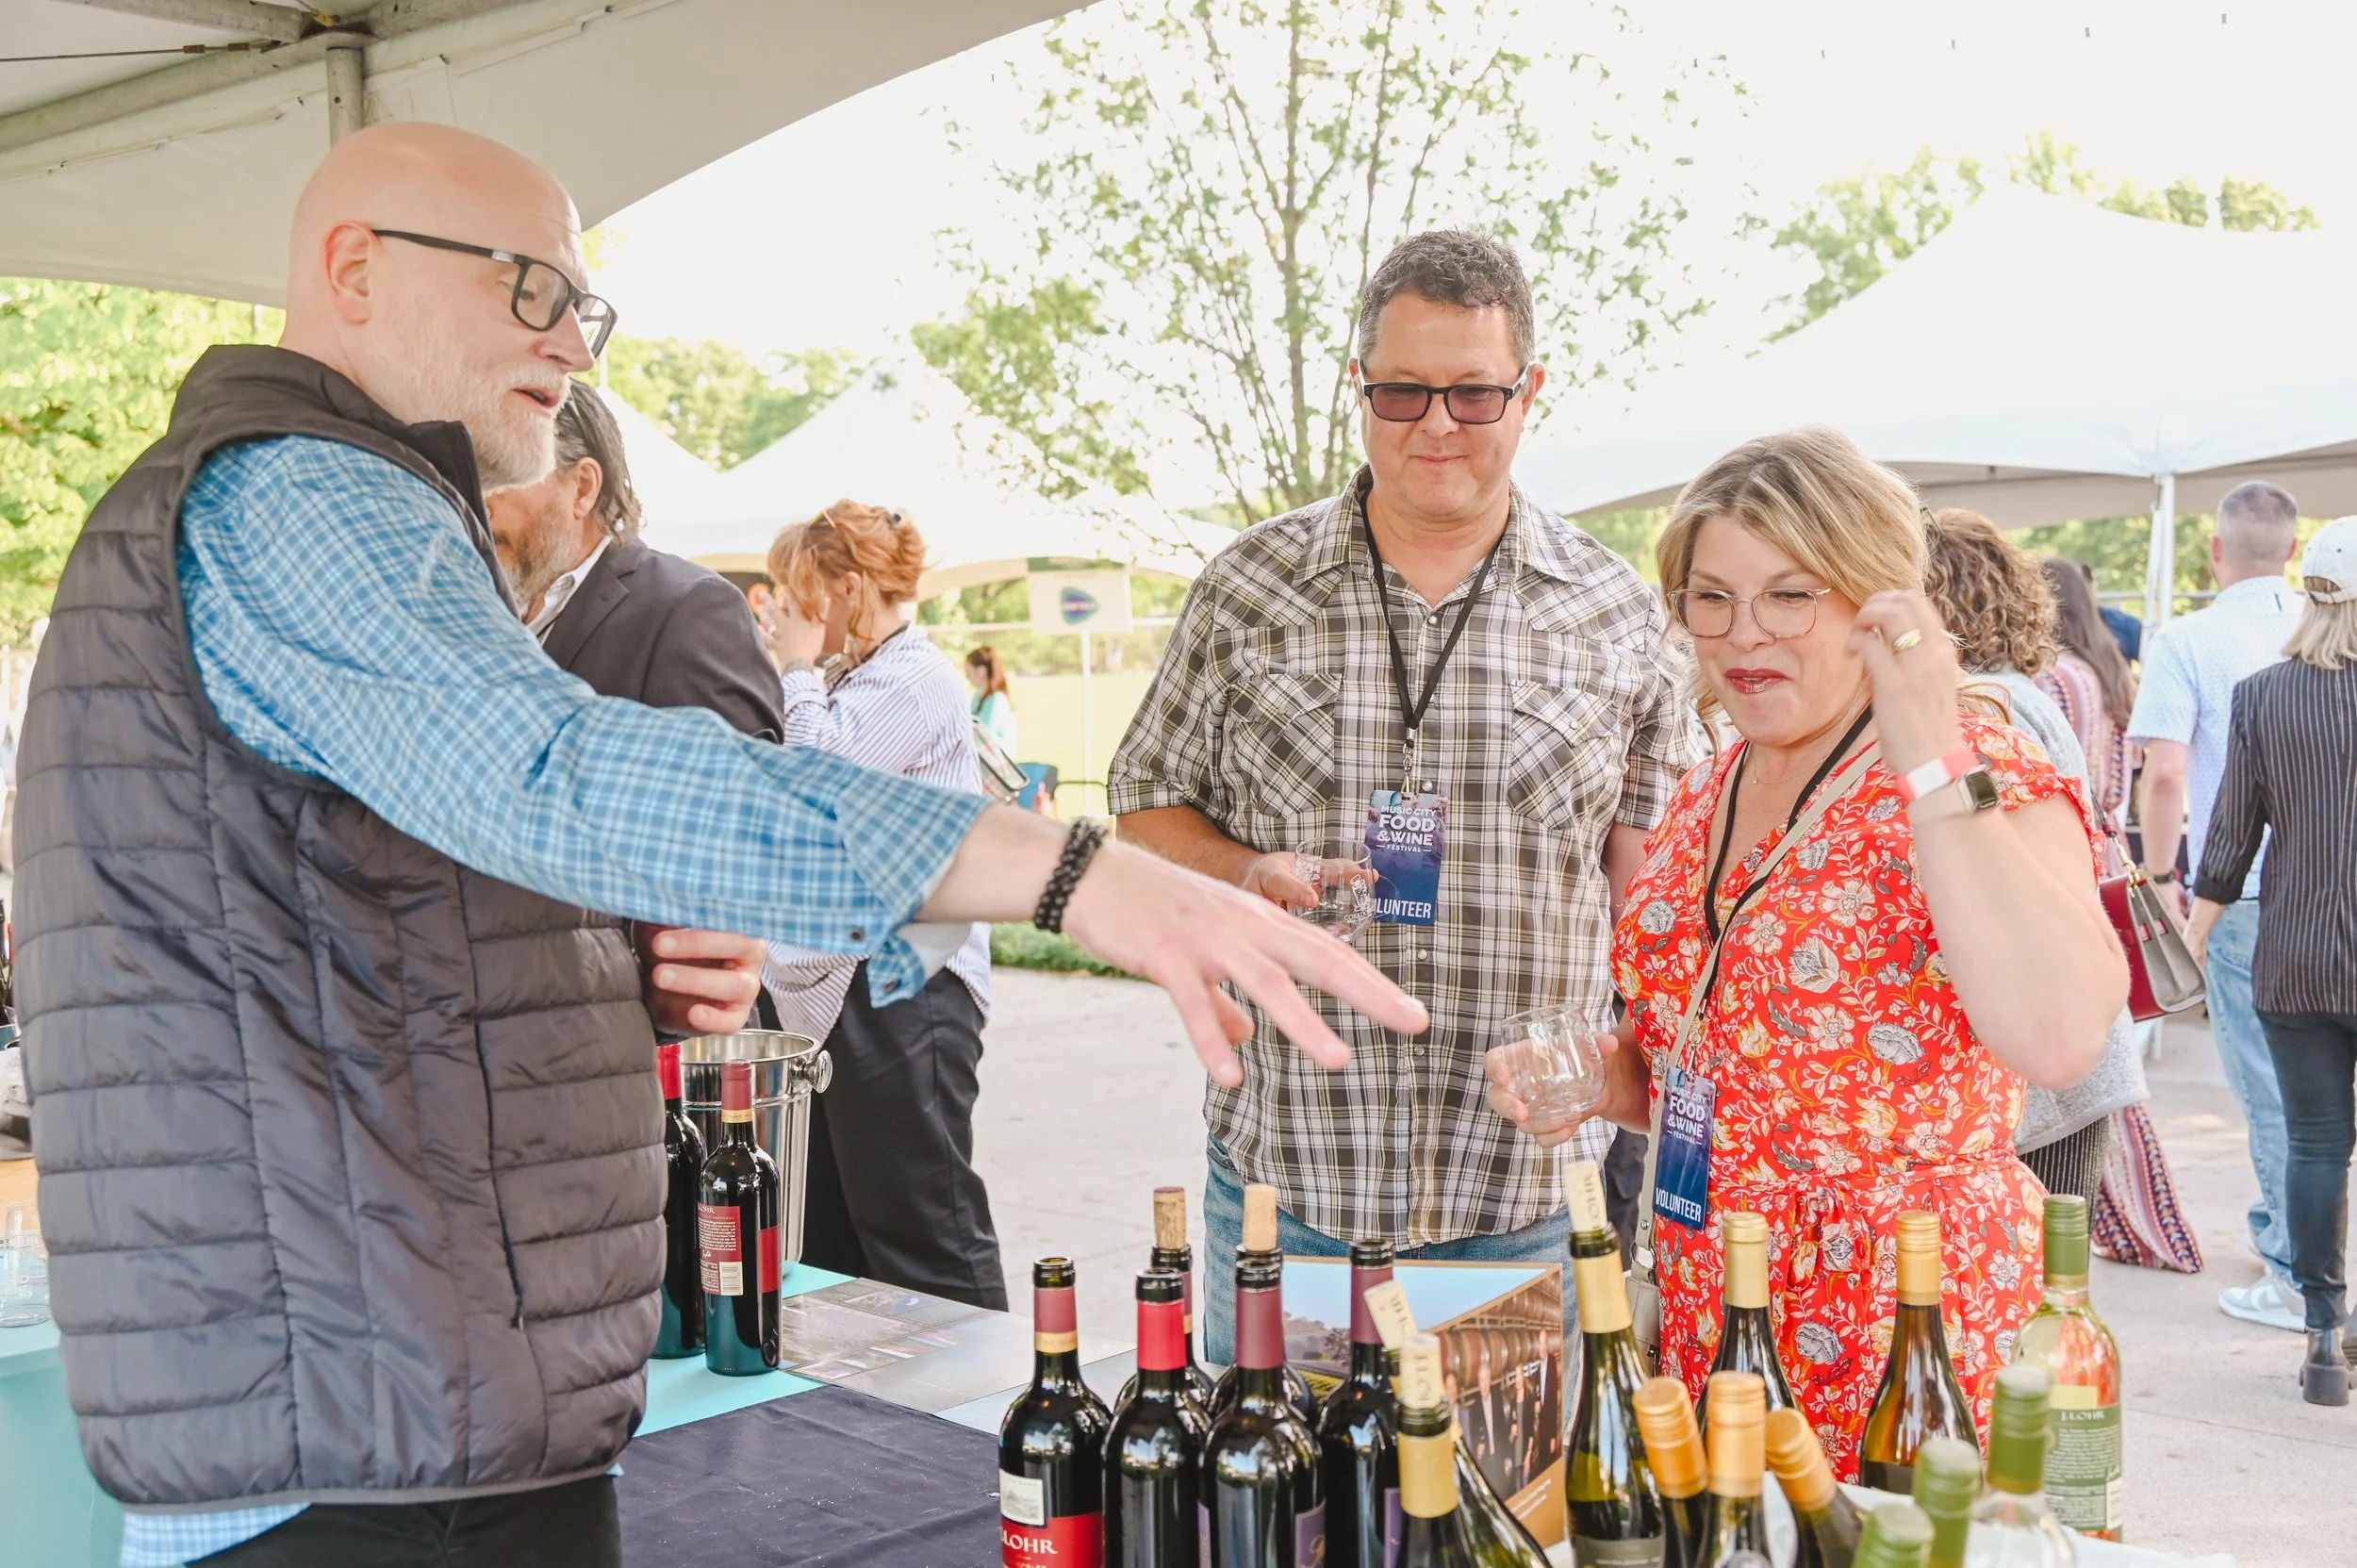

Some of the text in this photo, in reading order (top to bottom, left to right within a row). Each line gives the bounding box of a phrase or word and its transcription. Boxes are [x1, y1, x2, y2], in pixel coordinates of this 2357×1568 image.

[1381, 805, 1437, 817] MUSIC CITY
[1378, 814, 1436, 833] FOOD
[1376, 830, 1434, 846] &WINE
[1387, 844, 1422, 853] FESTIVAL
[1375, 898, 1432, 919] LUNTEER
[1672, 1085, 1707, 1104] MUSIC CITY
[1670, 1095, 1706, 1122] FOOD
[1667, 1114, 1705, 1139] &WINE
[1673, 1131, 1696, 1145] FESTIVAL
[1656, 1186, 1703, 1223] VOLUNTEER
